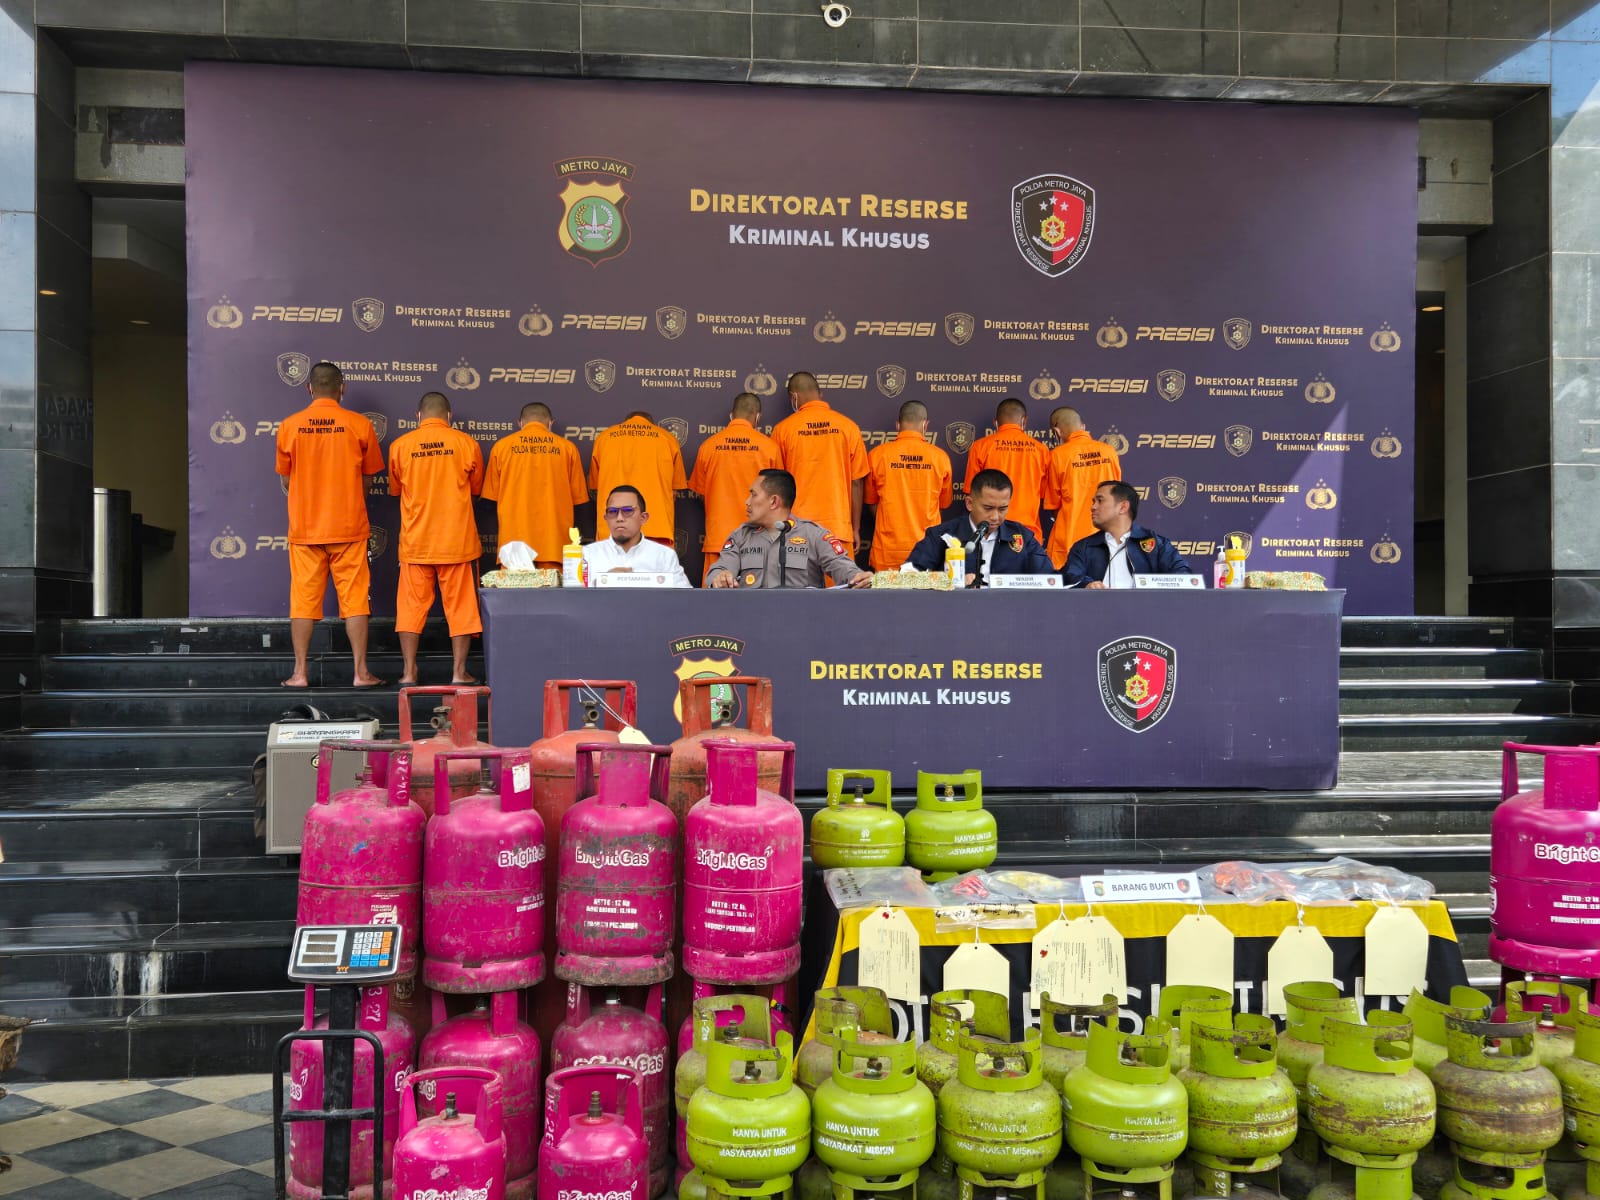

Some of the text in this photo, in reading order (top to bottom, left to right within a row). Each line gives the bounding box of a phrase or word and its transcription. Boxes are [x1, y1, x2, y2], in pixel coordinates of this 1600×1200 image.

[560, 159, 629, 177] METRO JAYA
[1019, 180, 1087, 198] POLDA METRO JAYA
[690, 189, 967, 219] DIREKTORAT RESERSE
[730, 225, 929, 249] KRIMINAL KHUSUS
[1014, 201, 1050, 271] DIREKTORAT RESERSE
[1067, 205, 1092, 265] KRIMINAL KHUSUS
[253, 306, 342, 322] PRESISI
[395, 305, 511, 318] DIREKTORAT RESERSE
[411, 318, 496, 328] KRIMINAL KHUSUS
[561, 314, 646, 330] PRESISI
[696, 313, 806, 325] DIREKTORAT RESERSE
[984, 320, 1088, 330] DIREKTORAT RESERSE
[712, 326, 791, 335] KRIMINAL KHUSUS
[854, 321, 936, 336] PRESISI
[1136, 327, 1214, 341] PRESISI
[1261, 324, 1363, 334] DIREKTORAT RESERSE
[998, 332, 1037, 340] KRIMINAL
[1315, 337, 1349, 345] KHUSUS
[321, 359, 440, 374] REKTORAT RESERSE
[626, 366, 736, 378] DIREKTORAT RESERSE
[343, 373, 424, 384] RIMINAL KHUSUS
[489, 368, 576, 383] PRESISI
[785, 374, 868, 390] ESISI
[916, 372, 1022, 382] DIREKTORAT RESERSE
[1195, 376, 1297, 386] DIREKTORAT RESERSE
[686, 380, 720, 388] KHUSUS
[930, 384, 969, 392] KRIMINAL
[1069, 378, 1148, 393] PRESISI
[1209, 388, 1248, 396] KRIMINAL
[466, 419, 515, 432] RESERSE
[519, 436, 554, 444] TAHANAN
[1136, 434, 1216, 448] PRESISI
[1262, 432, 1364, 441] DIREKTORAT RESERSE
[1196, 484, 1298, 492] DIREKTORAT RESERSE
[1251, 495, 1284, 503] KHUSUS
[1262, 538, 1363, 546] DIREKTORAT RESERSE
[1316, 549, 1350, 557] KHUSUS
[675, 639, 738, 652] METRO JAYA
[1104, 642, 1169, 657] POLDA METRO JAYA
[811, 660, 1041, 679] DIREKTORAT RESERSE
[844, 689, 1010, 705] KRIMINAL KHUSUS
[1100, 663, 1135, 729] DIREKTORAT RESERSE
[1151, 664, 1174, 721] KRIMINAL KHUSUS
[1111, 881, 1174, 892] BARANG BUKTI
[733, 1128, 787, 1138] HANYA UNTUK
[826, 1121, 879, 1136] HANYA UNTUK
